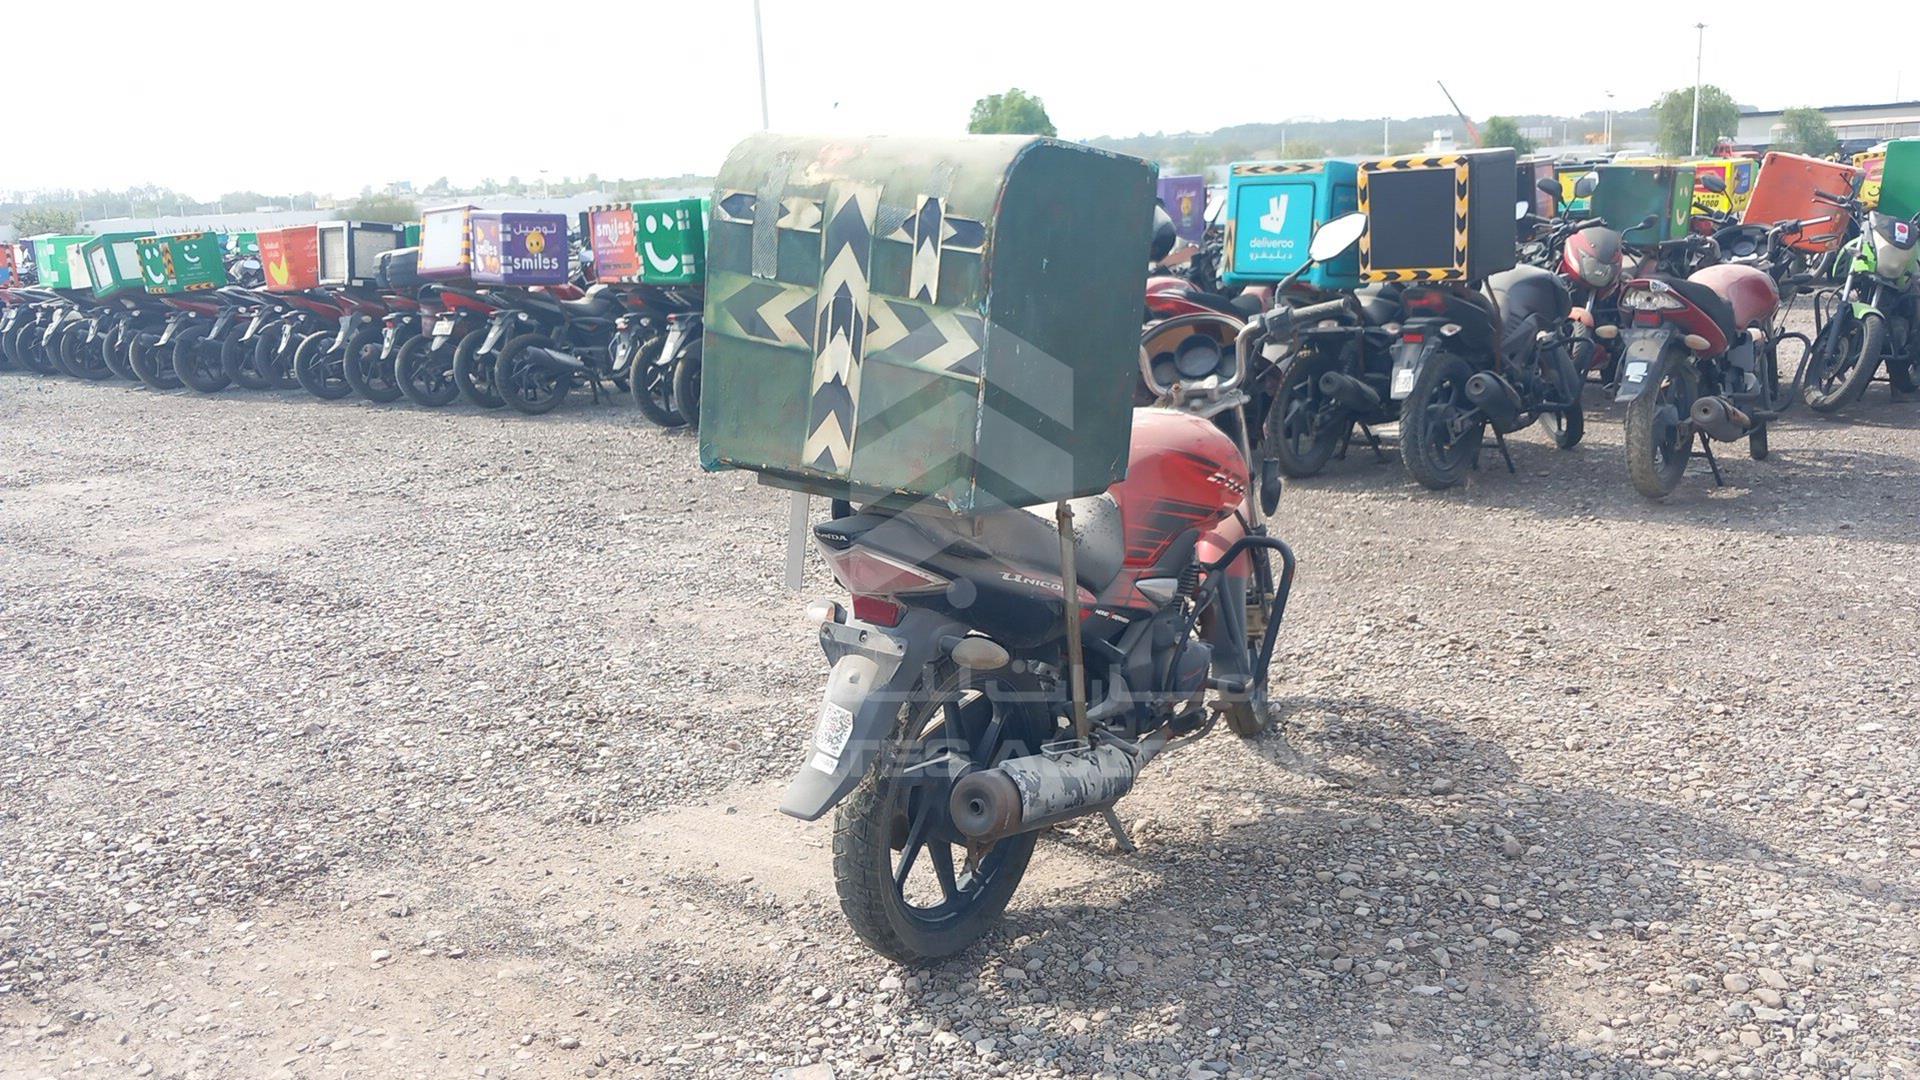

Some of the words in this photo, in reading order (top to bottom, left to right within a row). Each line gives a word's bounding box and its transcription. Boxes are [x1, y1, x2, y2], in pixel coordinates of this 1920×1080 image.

[513, 222, 557, 236] توصيل
[596, 217, 631, 237] smiles
[1249, 237, 1294, 249] deliveroo
[513, 253, 559, 270] smiles
[997, 571, 1065, 592] UNICO
